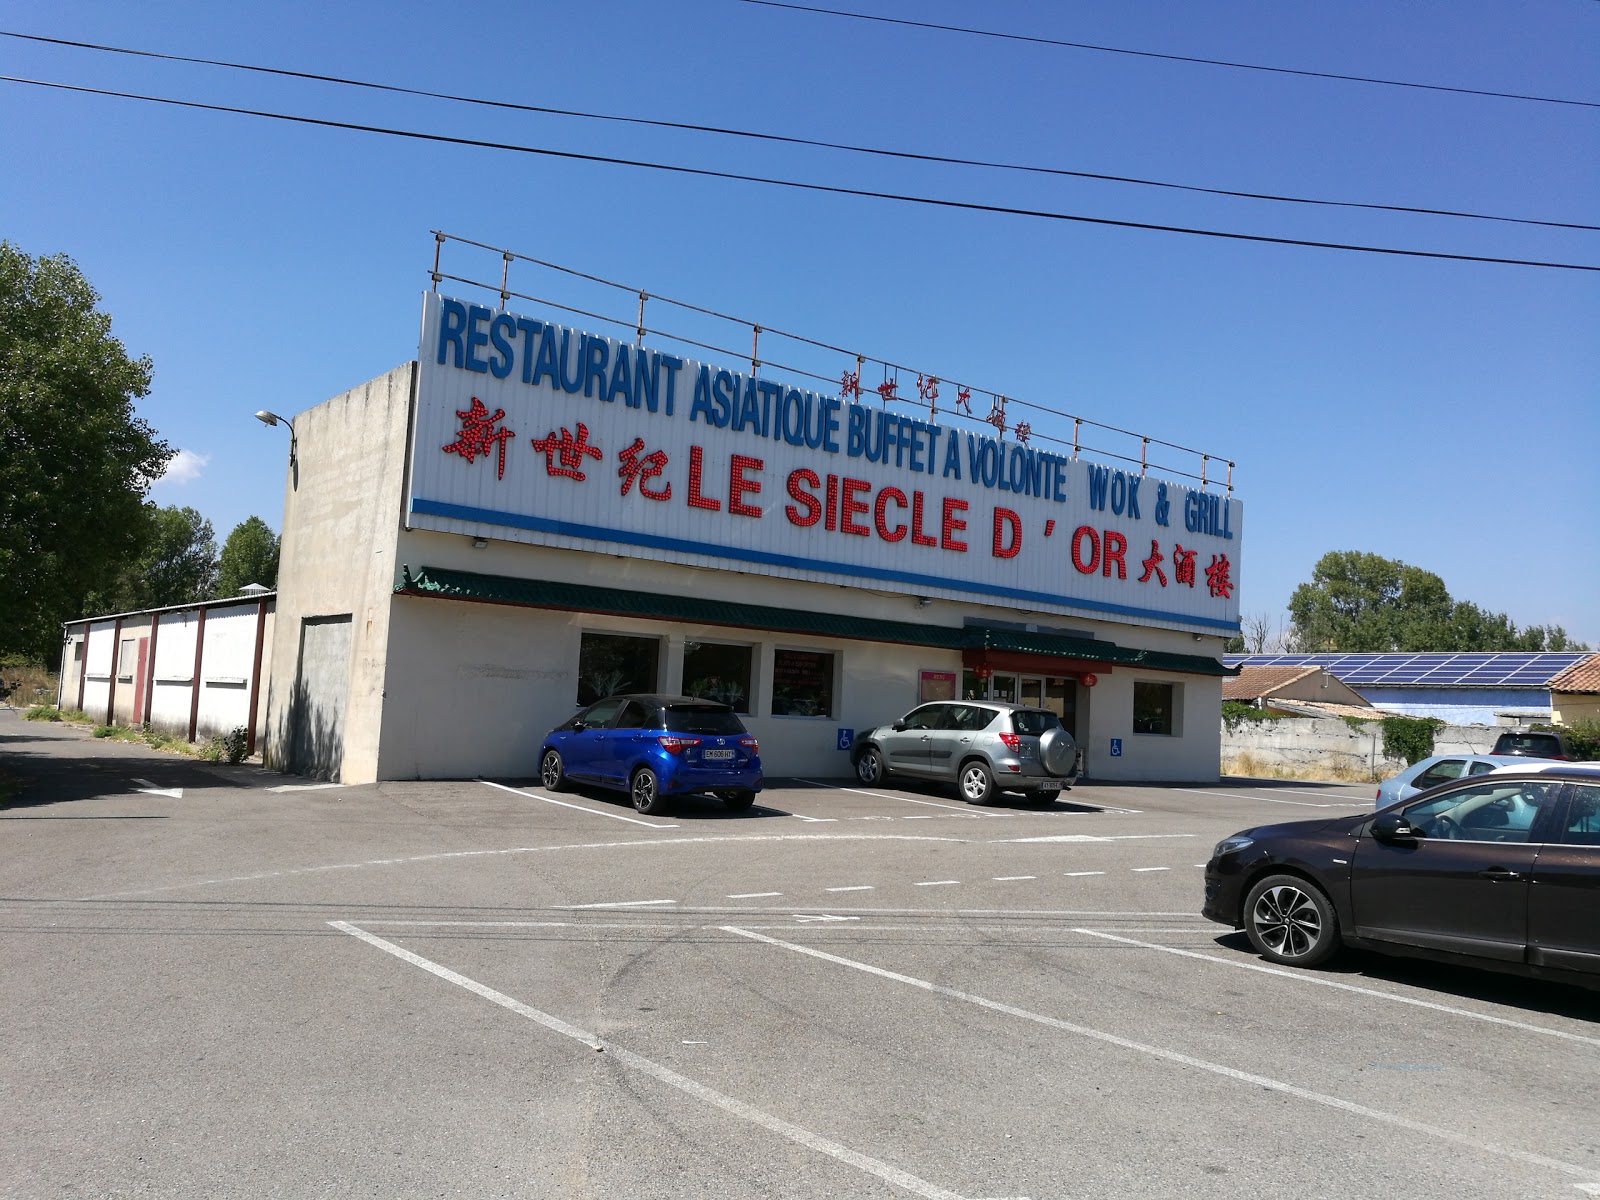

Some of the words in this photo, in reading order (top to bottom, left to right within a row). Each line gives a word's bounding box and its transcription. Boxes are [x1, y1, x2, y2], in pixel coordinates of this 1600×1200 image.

[438, 298, 683, 416] RESTAURANT
[690, 366, 841, 454] ASIATIQUE
[847, 402, 941, 475] BUFFET
[943, 430, 962, 480] A
[968, 434, 1068, 502] VOLONTE
[1088, 464, 1142, 520] WOK
[1155, 484, 1171, 527] &
[1185, 490, 1234, 540] GRILL
[688, 445, 764, 518] LE
[786, 469, 969, 552] SIECLE
